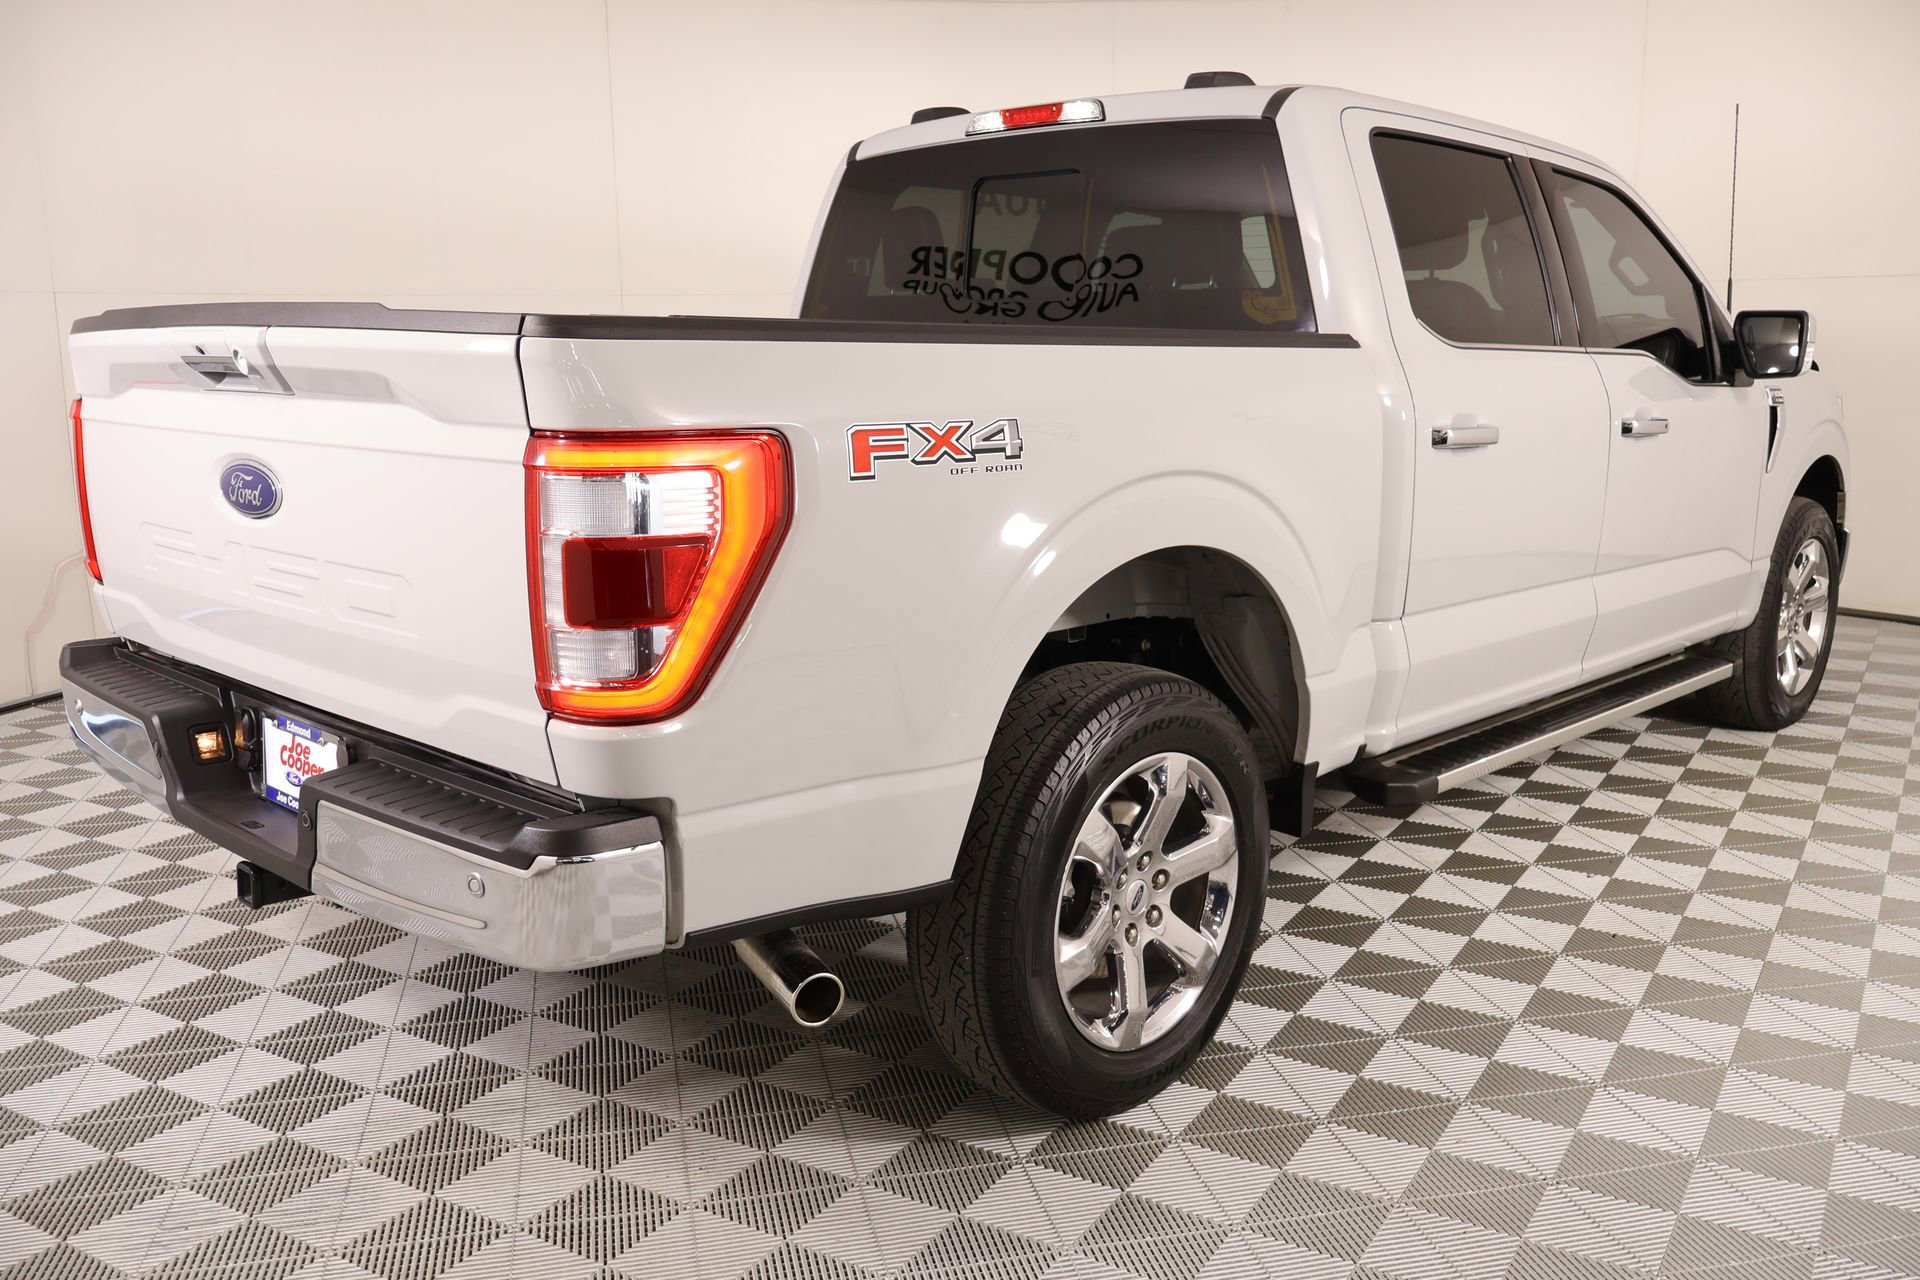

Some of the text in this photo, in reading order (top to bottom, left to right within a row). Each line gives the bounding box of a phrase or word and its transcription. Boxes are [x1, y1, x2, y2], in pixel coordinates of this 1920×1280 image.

[845, 418, 1023, 481] FX4
[950, 463, 1023, 476] OFF ROAD
[228, 471, 263, 506] Ford
[286, 720, 311, 738] Edmond
[1102, 714, 1216, 769] SCORPION
[280, 745, 325, 776] Cooper
[288, 735, 311, 760] Joe
[276, 791, 287, 805] Joe
